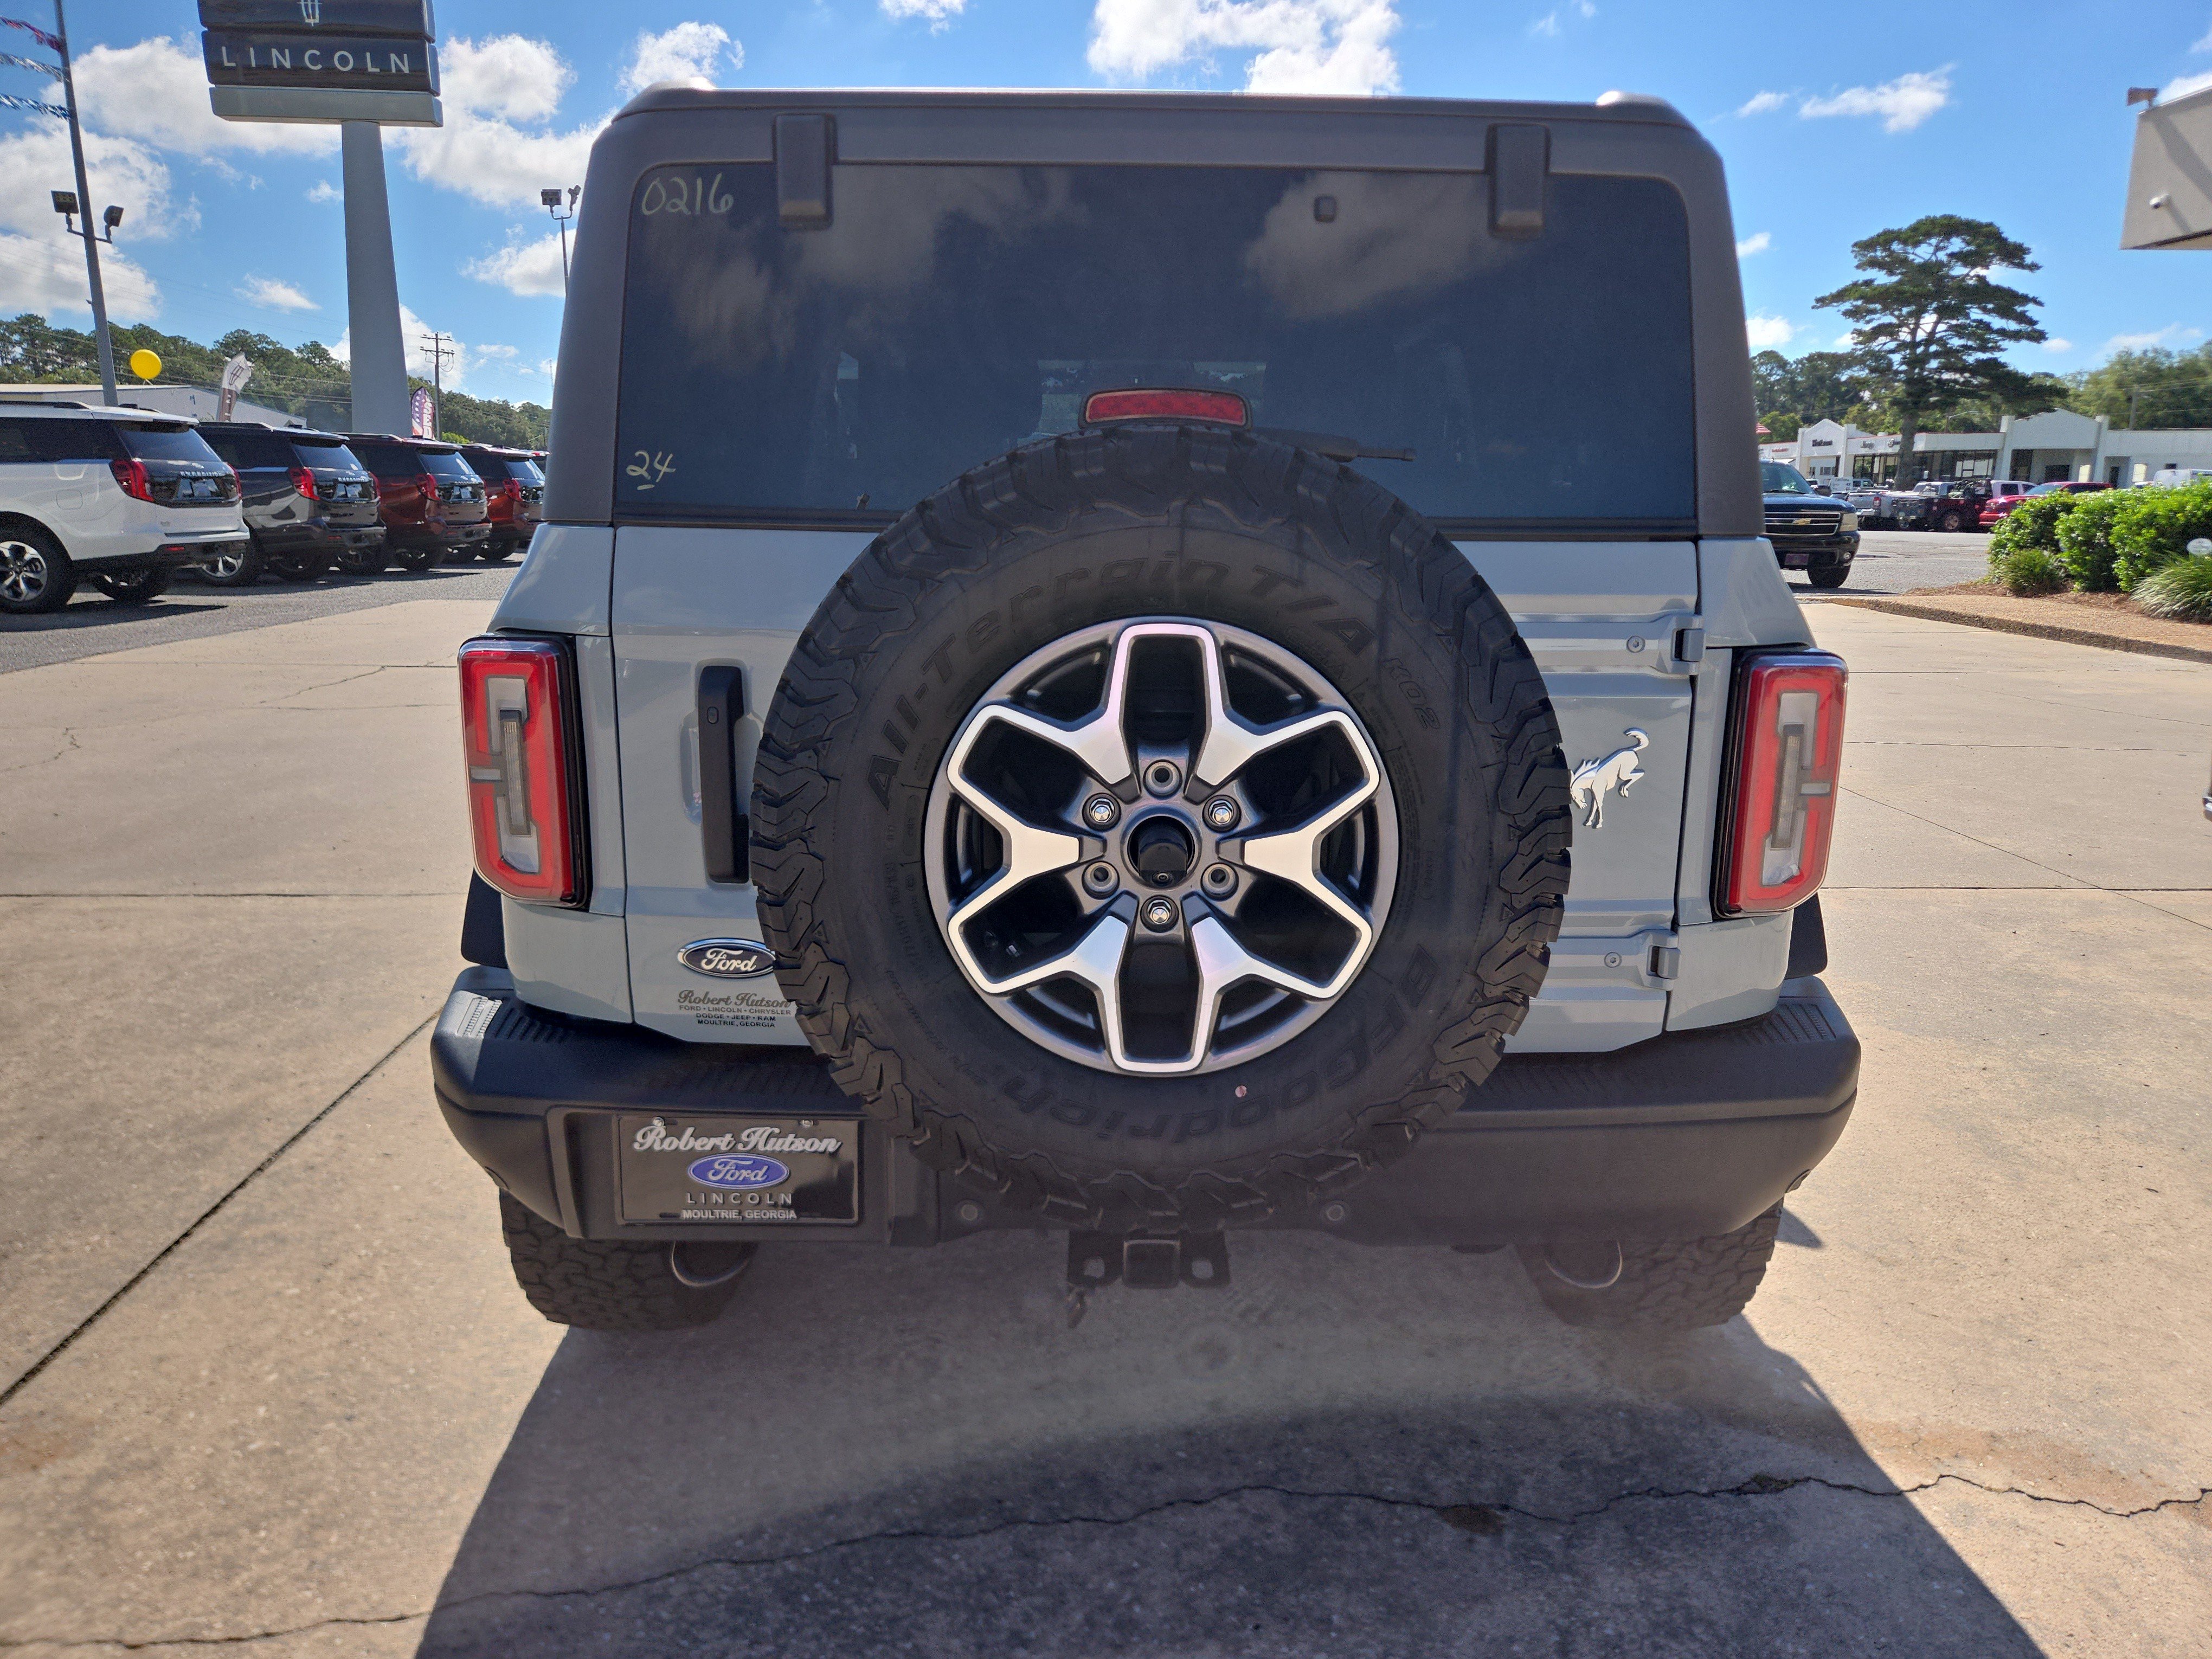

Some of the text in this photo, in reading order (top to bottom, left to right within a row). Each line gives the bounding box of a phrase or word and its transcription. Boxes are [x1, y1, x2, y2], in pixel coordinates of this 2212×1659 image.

[222, 47, 409, 74] LINCOLN
[642, 172, 734, 215] 0216
[626, 449, 677, 483] 24
[700, 948, 757, 972] Ford
[678, 989, 791, 1008] Robert Hutson
[633, 1126, 842, 1153] Robert Hutson
[709, 1159, 768, 1182] Ford
[686, 1192, 793, 1205] LINCOLN
[682, 1209, 797, 1220] MOULTRIE, GEORGIA
